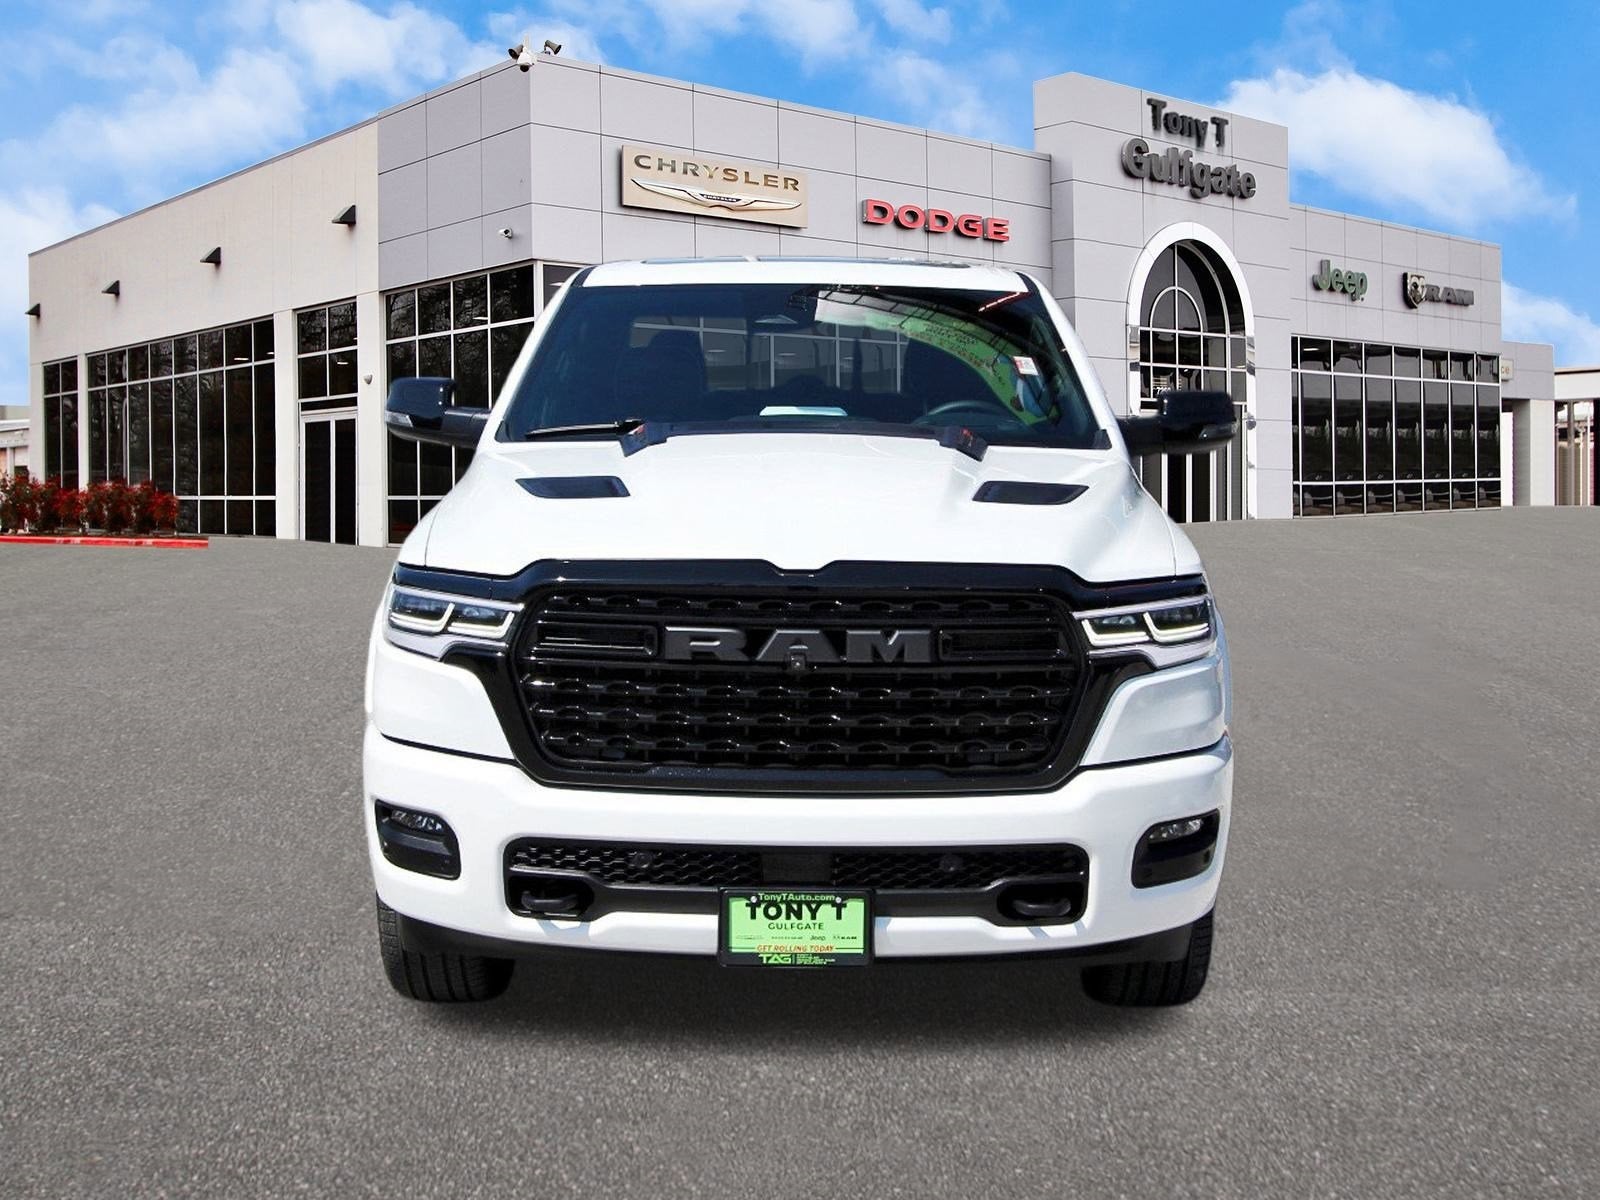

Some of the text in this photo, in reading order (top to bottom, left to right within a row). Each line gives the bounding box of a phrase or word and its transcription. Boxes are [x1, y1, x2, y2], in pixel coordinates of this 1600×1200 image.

[1146, 98, 1229, 147] Tony T
[633, 154, 801, 192] CHRYSLER
[1121, 137, 1257, 199] Gulfgate
[862, 199, 1010, 242] DODGE
[1312, 259, 1368, 302] Jeep
[1425, 284, 1475, 306] RAM
[664, 625, 932, 663] RAM
[745, 901, 847, 920] TONY T
[758, 893, 835, 902] TonyTAuto.com
[768, 922, 824, 930] GULFGATE
[757, 944, 835, 952] GET ROLLING TODAY
